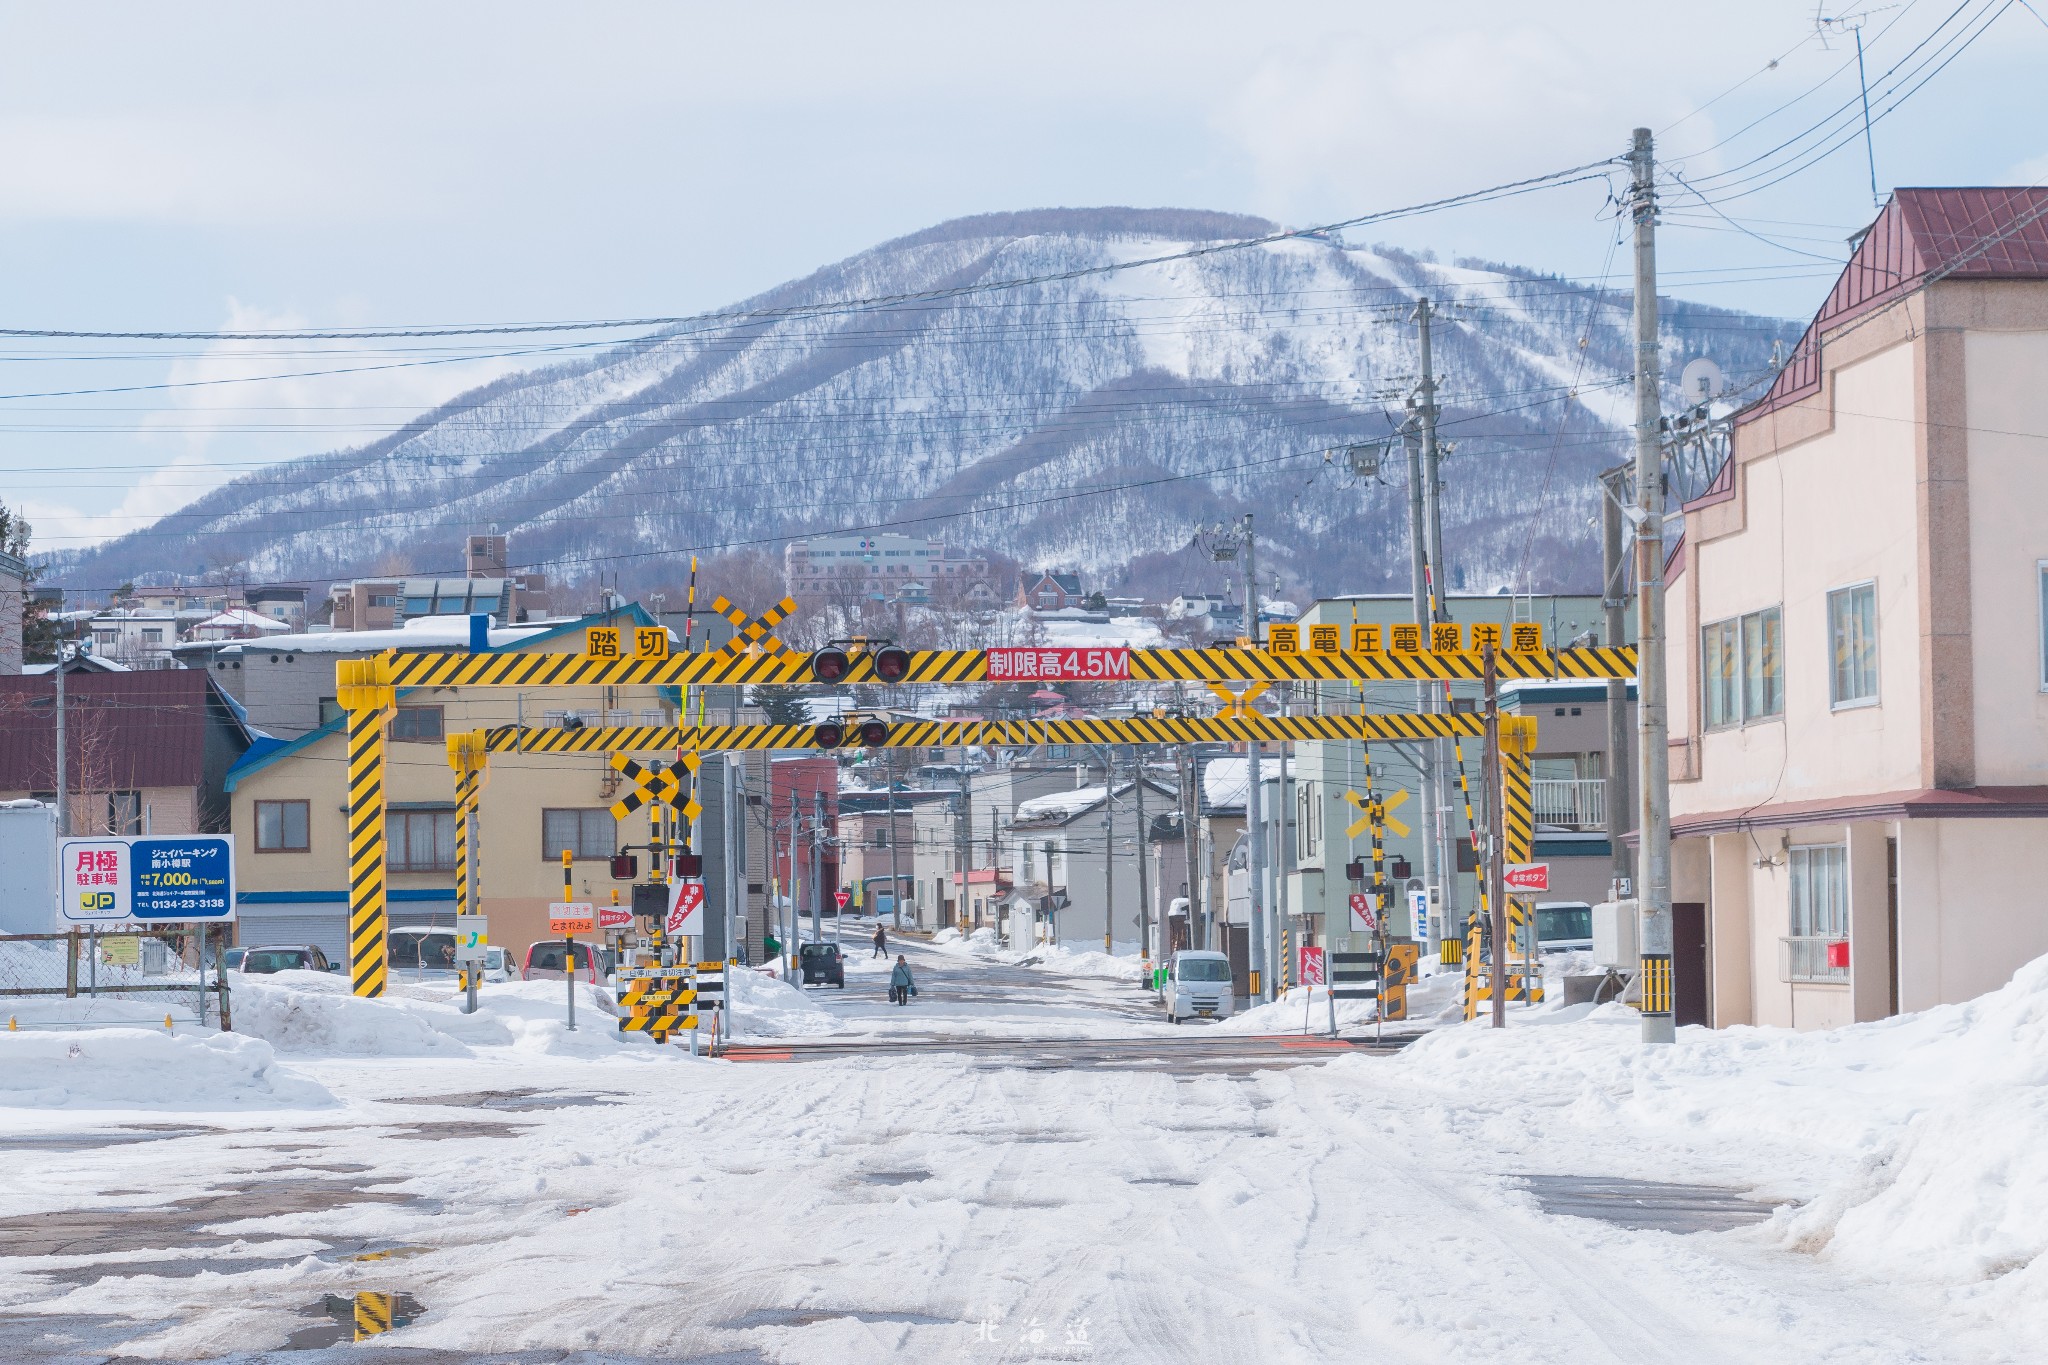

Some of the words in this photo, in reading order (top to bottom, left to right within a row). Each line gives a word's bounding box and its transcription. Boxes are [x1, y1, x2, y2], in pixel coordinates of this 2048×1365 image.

[590, 630, 664, 657] 踏切
[1272, 626, 1540, 654] 高電圧電線注意
[989, 651, 1129, 677] 制限高4.5M
[151, 848, 218, 858] ジェイパーキング
[75, 851, 118, 872] 月極
[151, 859, 191, 868] 南小樽駅
[76, 873, 118, 886] 駐車場
[1512, 873, 1546, 883] 非常ボタン
[82, 894, 113, 908] JP
[669, 885, 699, 929] 非常ボタン
[551, 921, 592, 931] とまれみよ
